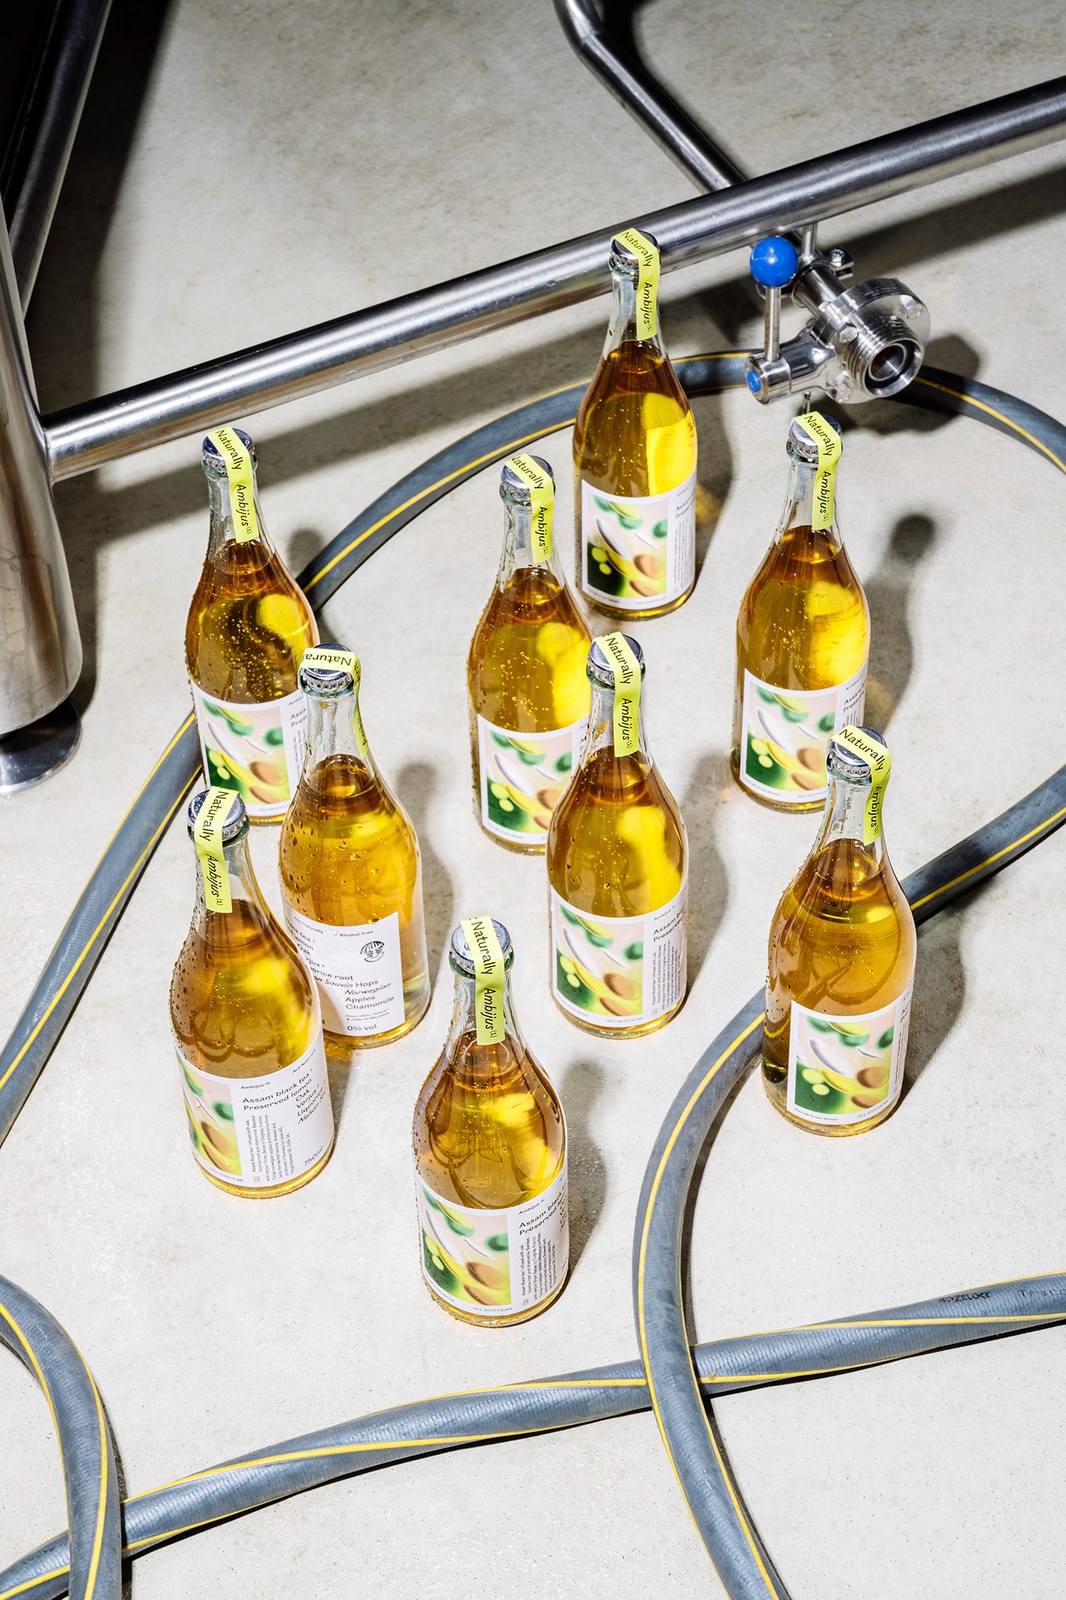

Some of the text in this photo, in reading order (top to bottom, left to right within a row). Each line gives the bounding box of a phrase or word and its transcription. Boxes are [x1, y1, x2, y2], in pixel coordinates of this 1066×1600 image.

[623, 232, 653, 267] Naturally
[215, 430, 244, 470] Naturally
[804, 416, 835, 456] Naturally
[305, 653, 352, 666] Natura
[606, 638, 634, 684] Naturally
[838, 728, 886, 772] Naturally
[199, 790, 229, 842] Naturally
[470, 921, 496, 975] Naturally
[356, 980, 378, 988] Hops
[346, 996, 395, 1010] Chamomile
[242, 1094, 274, 1103] Assam
[275, 1083, 297, 1097] black
[298, 1073, 310, 1084] tea
[243, 1095, 289, 1111] Preserved
[291, 1078, 312, 1097] lemon
[295, 1089, 310, 1102] Oak
[304, 1145, 324, 1166] 750ml
[519, 1211, 546, 1228] Assam
